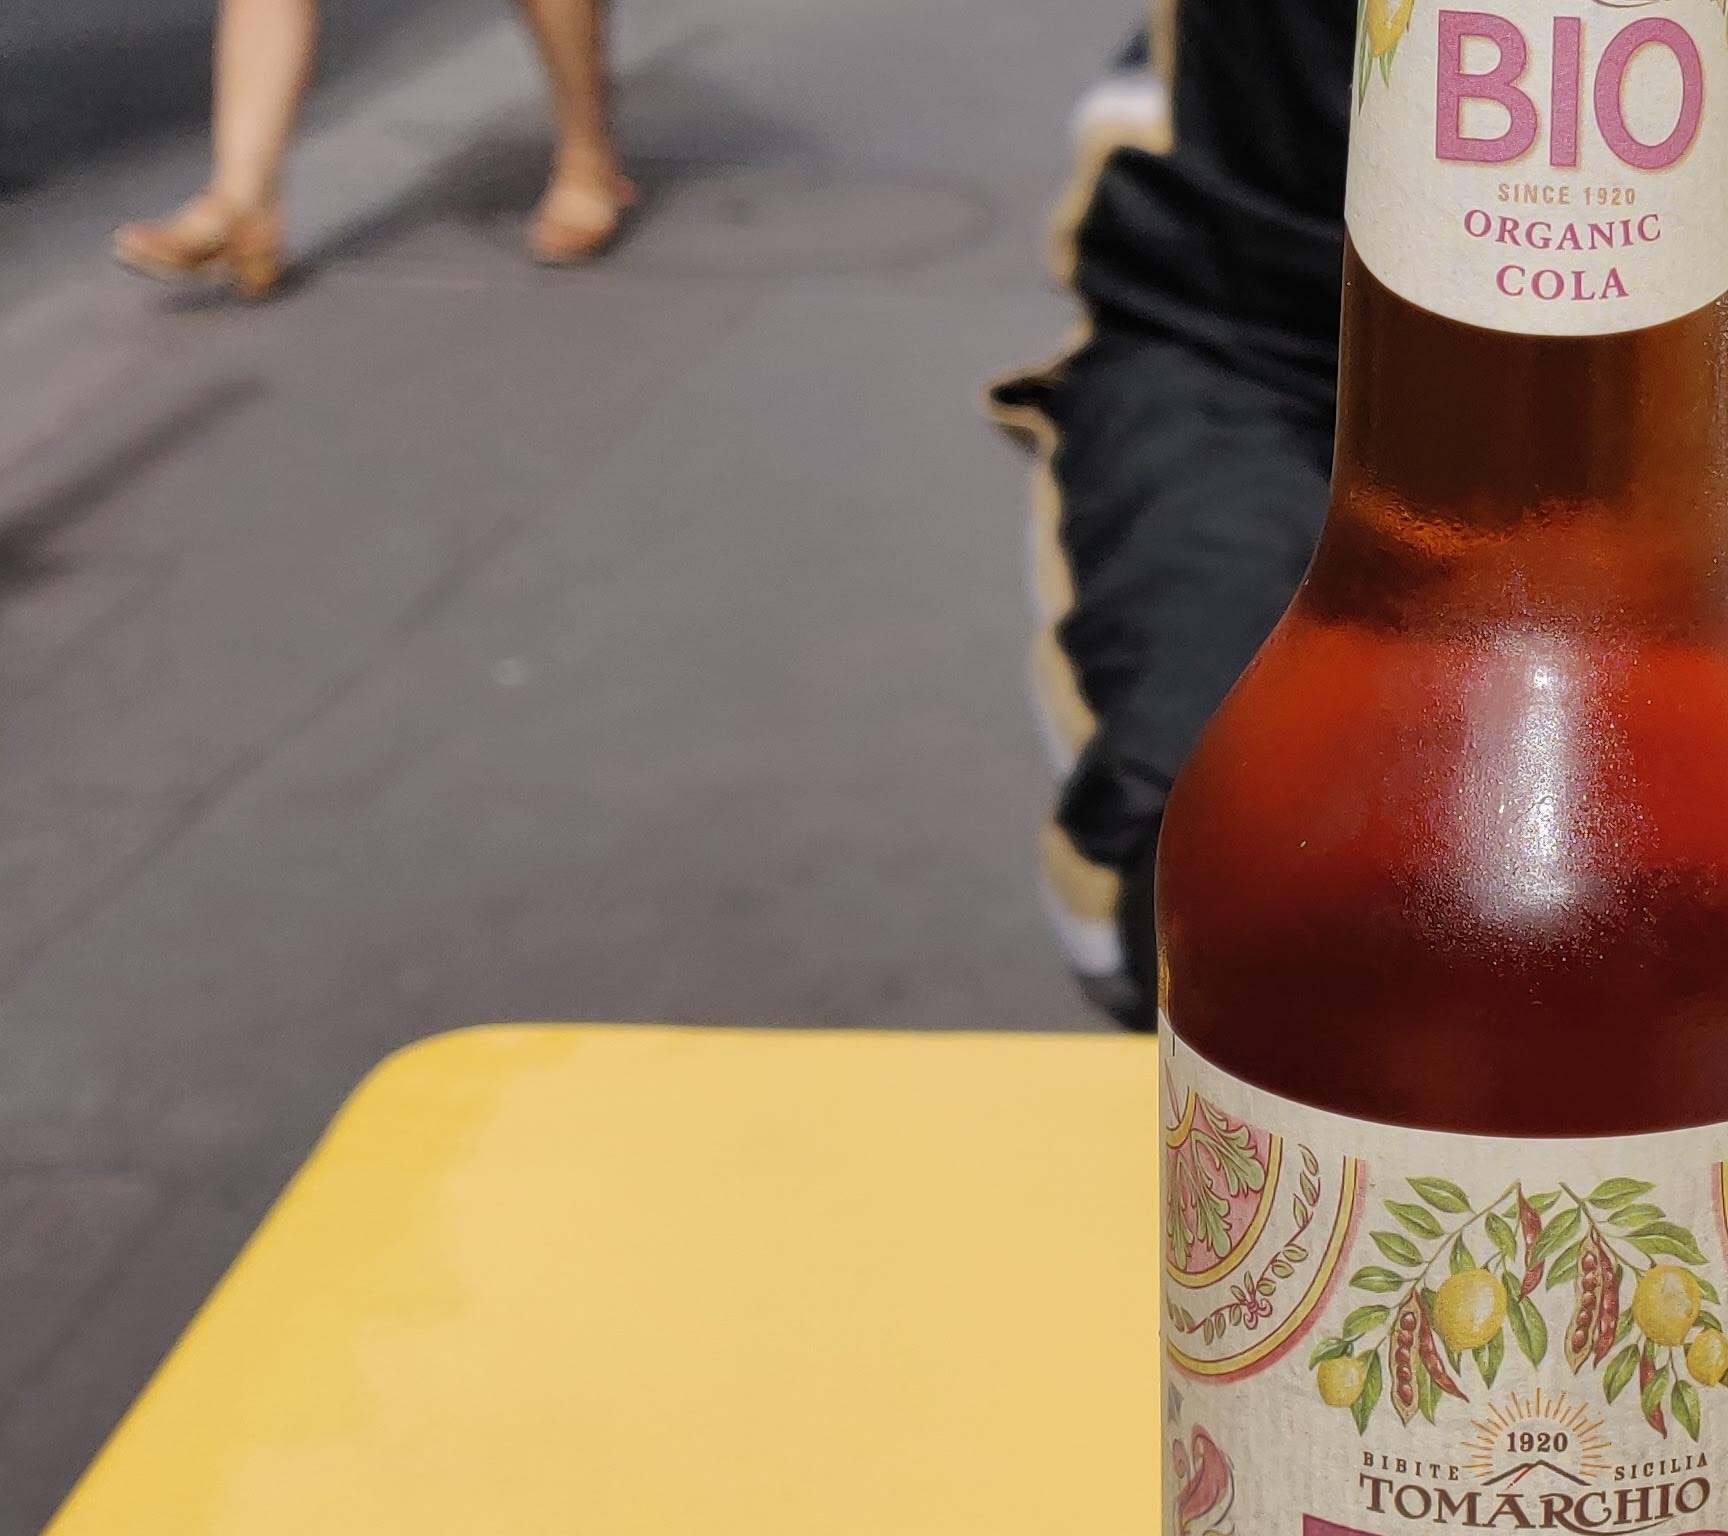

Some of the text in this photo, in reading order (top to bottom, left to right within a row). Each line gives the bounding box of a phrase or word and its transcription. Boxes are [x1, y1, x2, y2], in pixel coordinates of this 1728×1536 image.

[1435, 9, 1704, 170] BIO
[1498, 183, 1636, 205] SINCE 1920
[1464, 209, 1661, 250] ORGANIC
[1496, 264, 1629, 300] COLA
[1506, 1431, 1568, 1453] 1920
[1363, 1450, 1708, 1481] BIBITE SICILIA
[1359, 1472, 1711, 1536] TOMARCHIO
